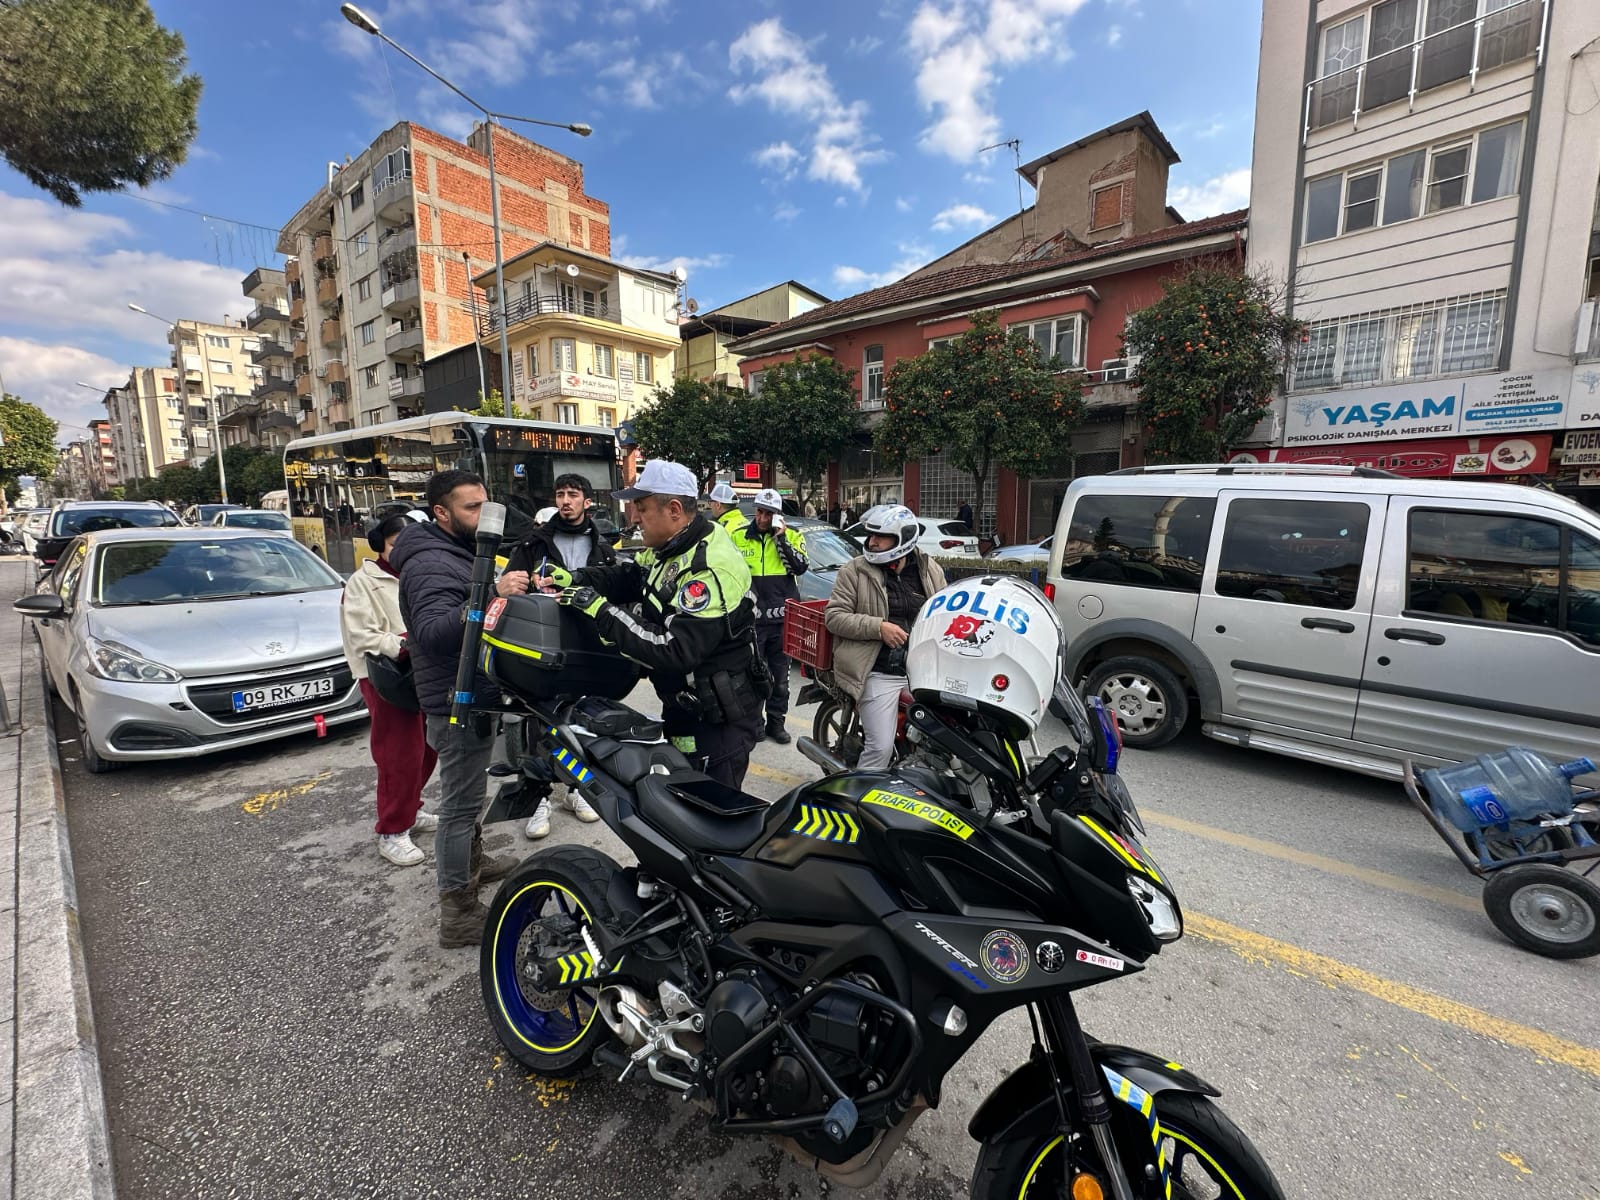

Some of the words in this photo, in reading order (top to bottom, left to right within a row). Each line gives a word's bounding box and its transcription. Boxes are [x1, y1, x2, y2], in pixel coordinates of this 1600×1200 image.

[1323, 396, 1456, 427] YAŞAM
[1347, 428, 1398, 439] DANIŞMA
[1401, 424, 1453, 435] MERKEZİ
[924, 591, 1030, 635] POLİS
[244, 690, 265, 705] 09
[271, 685, 295, 701] RK
[301, 679, 331, 695] 713
[914, 921, 979, 968] TRACER
